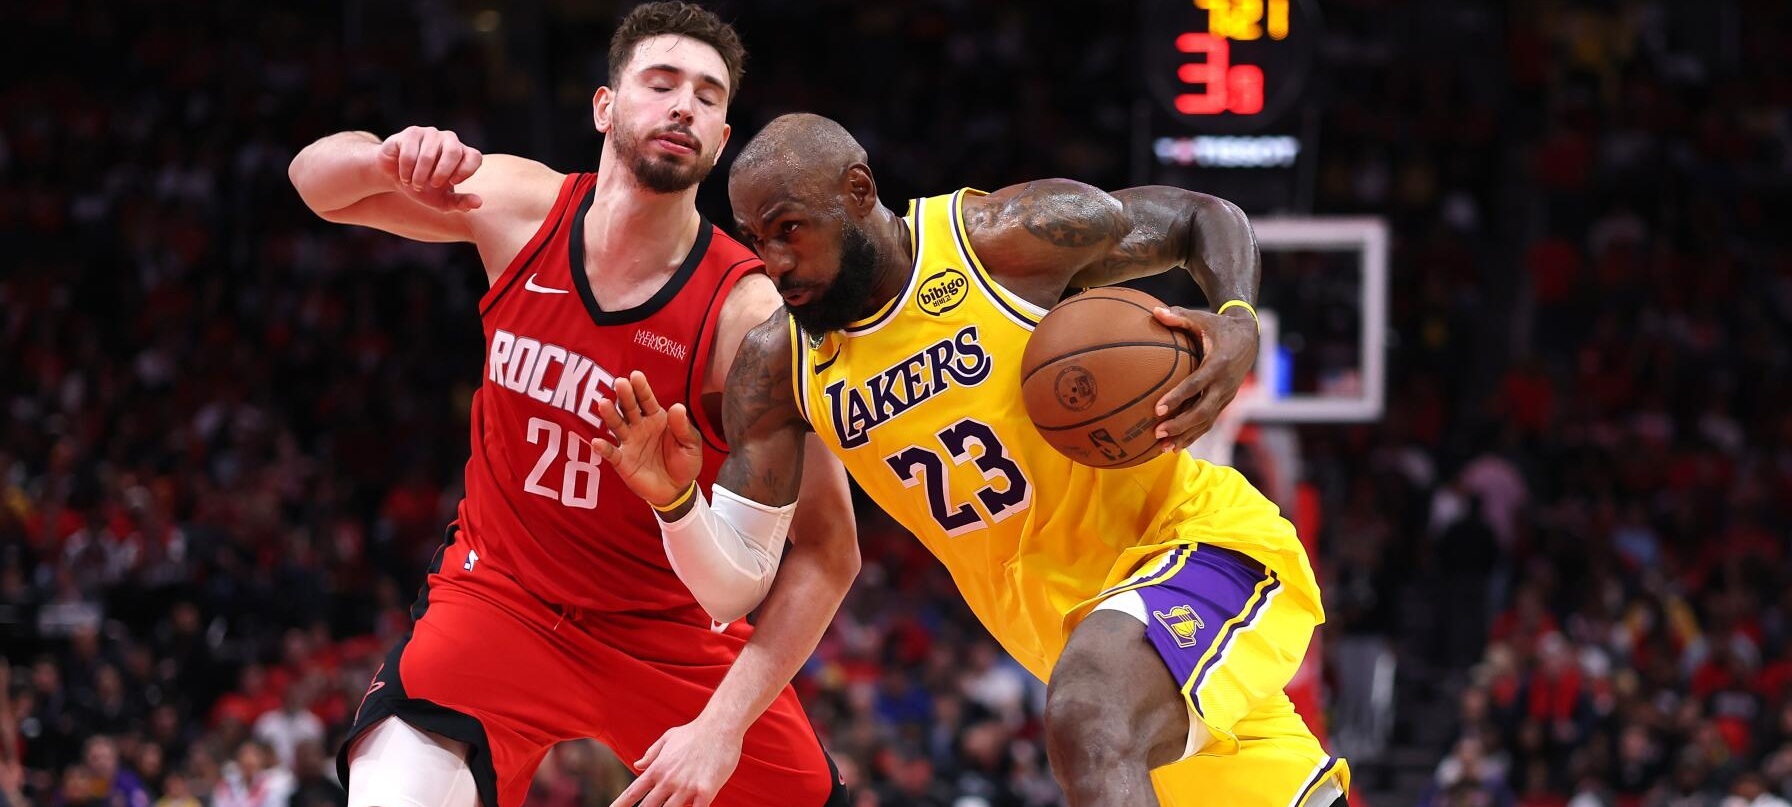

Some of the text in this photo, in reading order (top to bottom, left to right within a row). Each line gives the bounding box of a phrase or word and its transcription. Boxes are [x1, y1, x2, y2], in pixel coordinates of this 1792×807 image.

[920, 278, 964, 304] bibigo
[489, 329, 621, 429] ROCKE
[634, 335, 686, 361] HERMANN
[635, 329, 687, 353] MEMORIAL
[825, 326, 993, 449] LAKERS
[523, 416, 602, 510] 28
[882, 417, 1033, 539] 23
